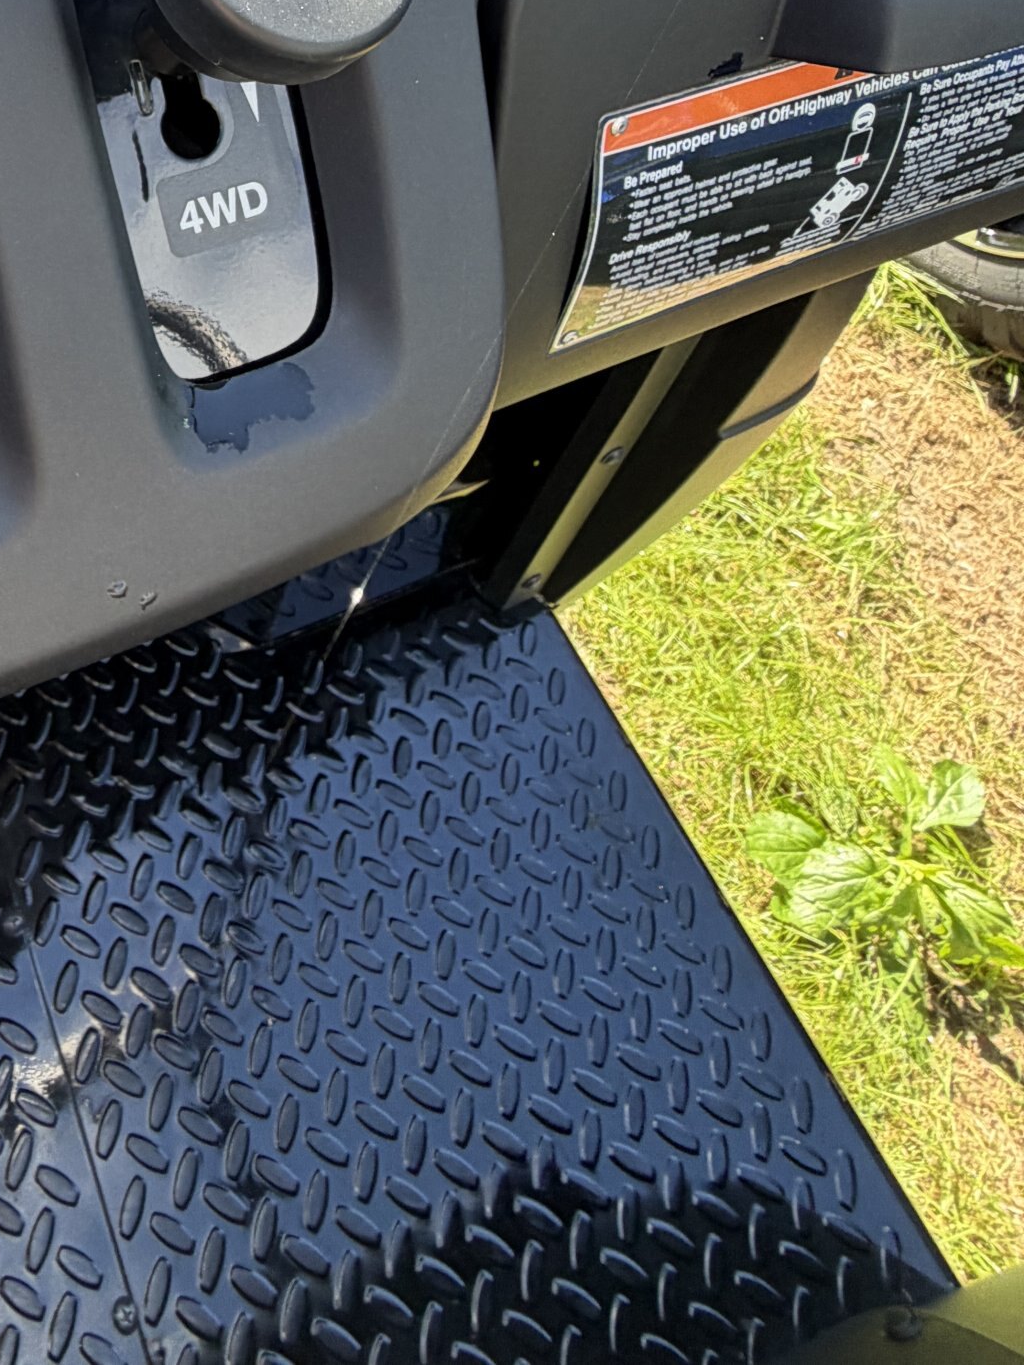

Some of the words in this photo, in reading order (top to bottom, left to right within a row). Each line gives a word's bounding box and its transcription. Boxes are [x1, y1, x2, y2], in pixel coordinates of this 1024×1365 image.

[920, 83, 932, 95] Be
[933, 77, 953, 92] Sure
[953, 64, 995, 85] Occupants
[648, 130, 717, 161] Improper
[719, 124, 747, 140] Use
[751, 113, 766, 130] of
[768, 88, 852, 122] Off-Highway
[855, 73, 910, 99] Vehicles
[624, 175, 638, 190] Be
[639, 160, 684, 185] Prepared
[179, 180, 270, 236] 4WD
[608, 250, 634, 265] Drive
[634, 230, 692, 257] Responsibly
